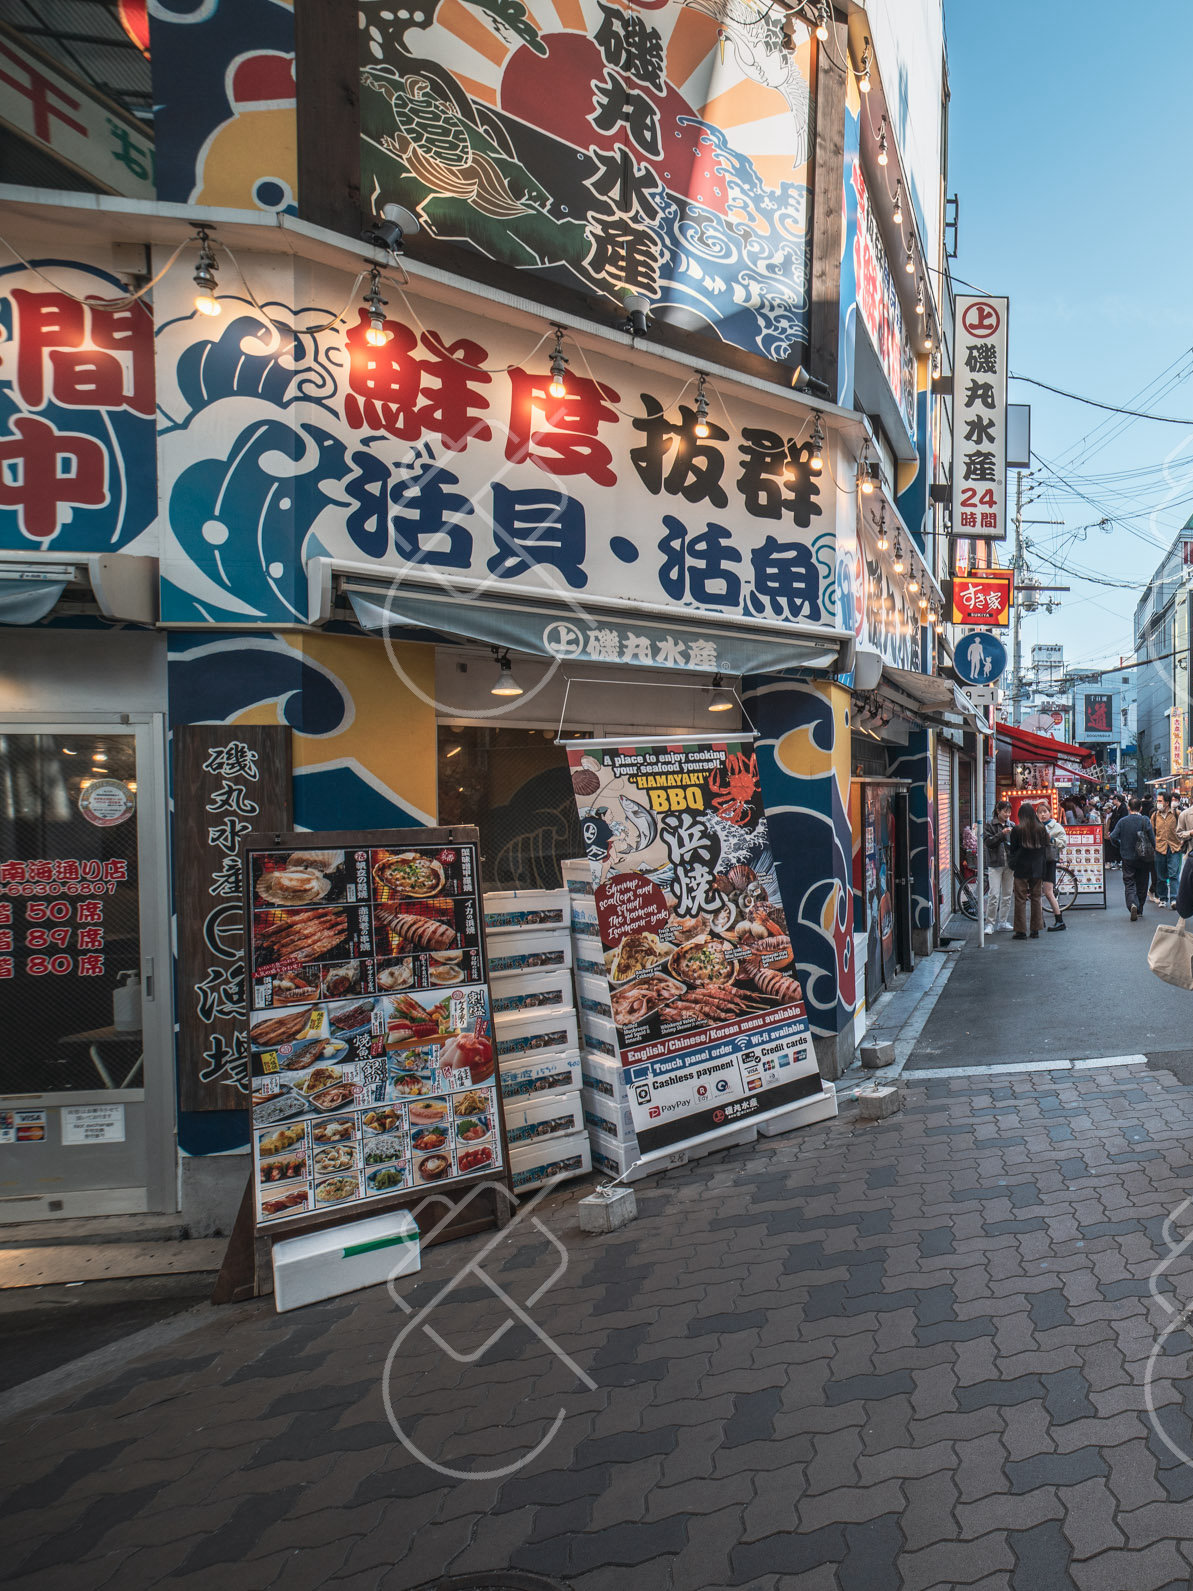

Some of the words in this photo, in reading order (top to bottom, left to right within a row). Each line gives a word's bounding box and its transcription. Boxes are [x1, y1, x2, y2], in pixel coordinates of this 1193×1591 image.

[585, 9, 666, 299] 磯丸水産
[965, 304, 997, 335] 上
[345, 307, 824, 528] 鮮度抜群
[963, 343, 997, 484] 磯丸水産
[960, 488, 997, 509] 24
[960, 512, 997, 530] 時間
[346, 450, 822, 620] 活貝・活魚
[960, 583, 1001, 612] すき家
[586, 628, 718, 671] 磯丸水産
[604, 756, 612, 765] A
[615, 754, 643, 766] place
[646, 754, 655, 763] to
[659, 752, 686, 765] enjoy
[689, 751, 726, 763] cooking
[614, 766, 638, 776] your
[641, 763, 679, 774] seafood
[682, 761, 723, 771] yourself.
[649, 787, 704, 813] BBQ
[0, 858, 128, 882] 南海通り店
[662, 813, 723, 915] 浜焼
[0, 882, 116, 896] -6630-6801
[599, 890, 634, 910] scallops
[637, 883, 653, 895] and
[606, 879, 642, 895] Shrimp,
[609, 916, 624, 926] The
[626, 904, 657, 923] famous
[617, 897, 643, 916] squid!
[468, 990, 486, 1018] 刺盛
[353, 1033, 373, 1062] 焼魚
[627, 1024, 739, 1062] English/Chinese/Korean
[741, 1018, 763, 1032] menu
[765, 1006, 801, 1027] available
[750, 1031, 769, 1045] Wi-fi
[770, 1023, 804, 1039] available
[761, 1042, 784, 1056] Credit
[786, 1036, 808, 1049] cards
[654, 1059, 682, 1073] Touch
[685, 1051, 710, 1067] panel
[711, 1045, 733, 1058] order
[652, 1071, 694, 1090] Cashless
[696, 1059, 734, 1079] payment
[661, 1099, 691, 1113] PayPay
